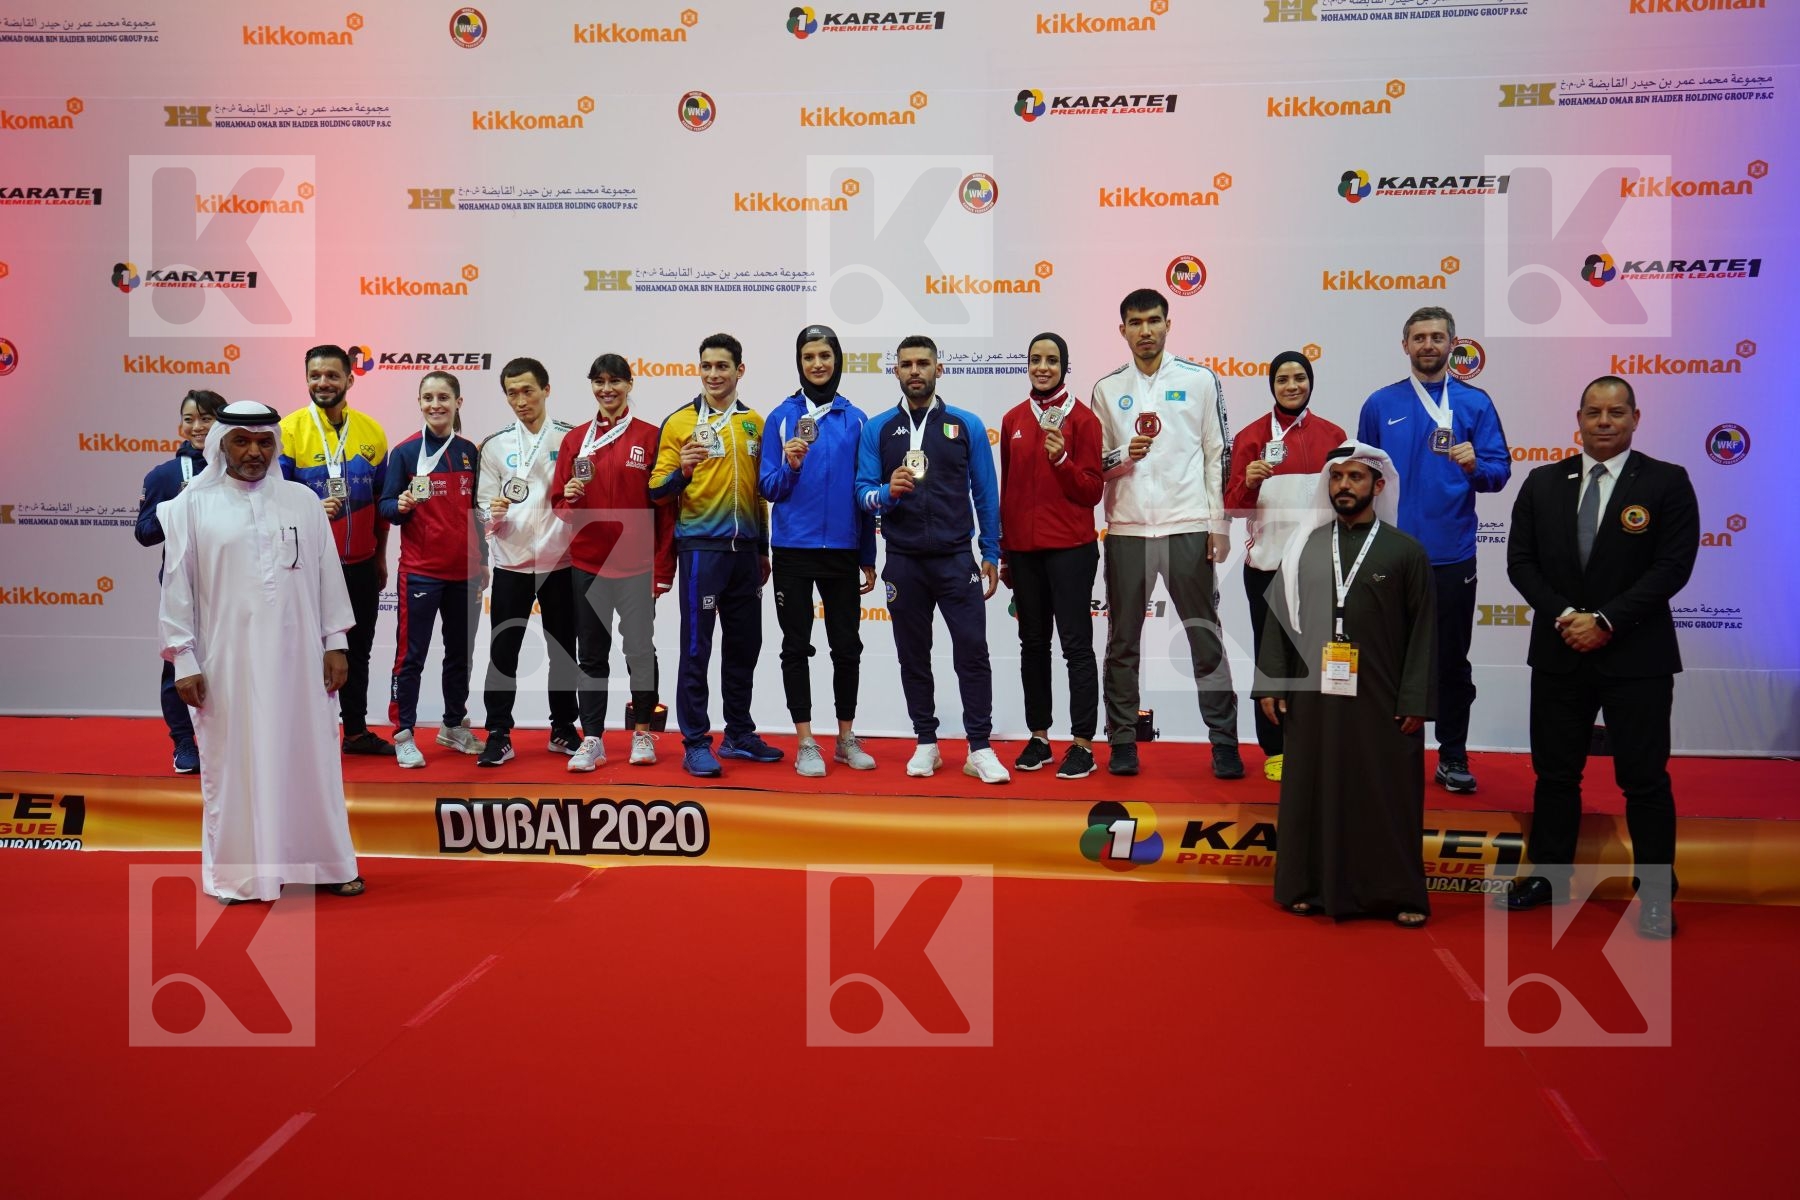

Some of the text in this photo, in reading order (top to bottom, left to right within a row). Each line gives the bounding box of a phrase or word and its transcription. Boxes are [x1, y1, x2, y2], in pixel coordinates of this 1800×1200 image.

[1370, 12, 1393, 20] OMAR
[1395, 12, 1408, 20] BIN
[1410, 11, 1440, 19] HAIDER
[1442, 9, 1479, 18] HOLDING
[1481, 8, 1508, 16] GROUP
[41, 18, 59, 30] حيدر
[77, 18, 92, 30] عمر
[96, 18, 119, 30] محمد
[122, 18, 155, 30] مجموعة
[824, 11, 945, 30] KARATE1
[1036, 13, 1156, 34] kikkoman
[459, 24, 476, 32] WKF
[574, 23, 686, 43] kikkoman
[243, 25, 352, 46] kikkoman
[1631, 79, 1656, 89] حيدر
[1677, 77, 1696, 87] عمر
[1700, 77, 1727, 85] محمد
[1731, 74, 1772, 84] مجموعة
[1052, 94, 1177, 112] KARATE1
[1559, 97, 1607, 106] MOHAMMAD
[1610, 96, 1633, 104] OMAR
[1636, 95, 1650, 103] BIN
[1685, 93, 1722, 101] HOLDING
[1725, 92, 1753, 100] GROUP
[274, 106, 293, 114] حيدر
[310, 107, 326, 115] عمر
[356, 103, 389, 114] مجموعة
[688, 107, 705, 116] WKF
[1267, 96, 1390, 118] kikkoman
[473, 111, 583, 130] kikkoman
[800, 107, 915, 126] kikkoman
[216, 120, 391, 128] MOHAMMAD OMAR BIN HAIDER HOLDING GROUP P.S.C
[602, 186, 635, 195] مجموعة
[1378, 175, 1510, 194] KARATE1
[1621, 176, 1753, 198] kikkoman
[518, 188, 538, 197] حيدر
[556, 189, 572, 197] عمر
[969, 190, 987, 198] WKF
[1100, 187, 1218, 207] kikkoman
[195, 194, 303, 214] kikkoman
[459, 202, 637, 210] MOHAMMAD OMAR BIN HAIDER HOLDING GROUP P.S.C
[734, 192, 847, 212] kikkoman
[780, 267, 814, 279] مجموعة
[1623, 259, 1762, 278] KARATE1
[146, 271, 257, 288] KARATE1
[696, 271, 716, 279] حيدر
[734, 271, 750, 279] عمر
[1176, 272, 1195, 280] WKF
[1323, 270, 1446, 290] kikkoman
[360, 277, 467, 296] kikkoman
[926, 275, 1040, 294] kikkoman
[124, 356, 230, 374] kikkoman
[380, 353, 492, 370] KARATE1
[1454, 356, 1473, 364] WKF
[1611, 354, 1741, 375] kikkoman
[1718, 440, 1738, 448] WKF
[0, 587, 103, 605] kikkoman
[441, 803, 705, 851] DUBAI 2020
[1176, 853, 1274, 867] PREM
[1426, 878, 1465, 891] UBAI
